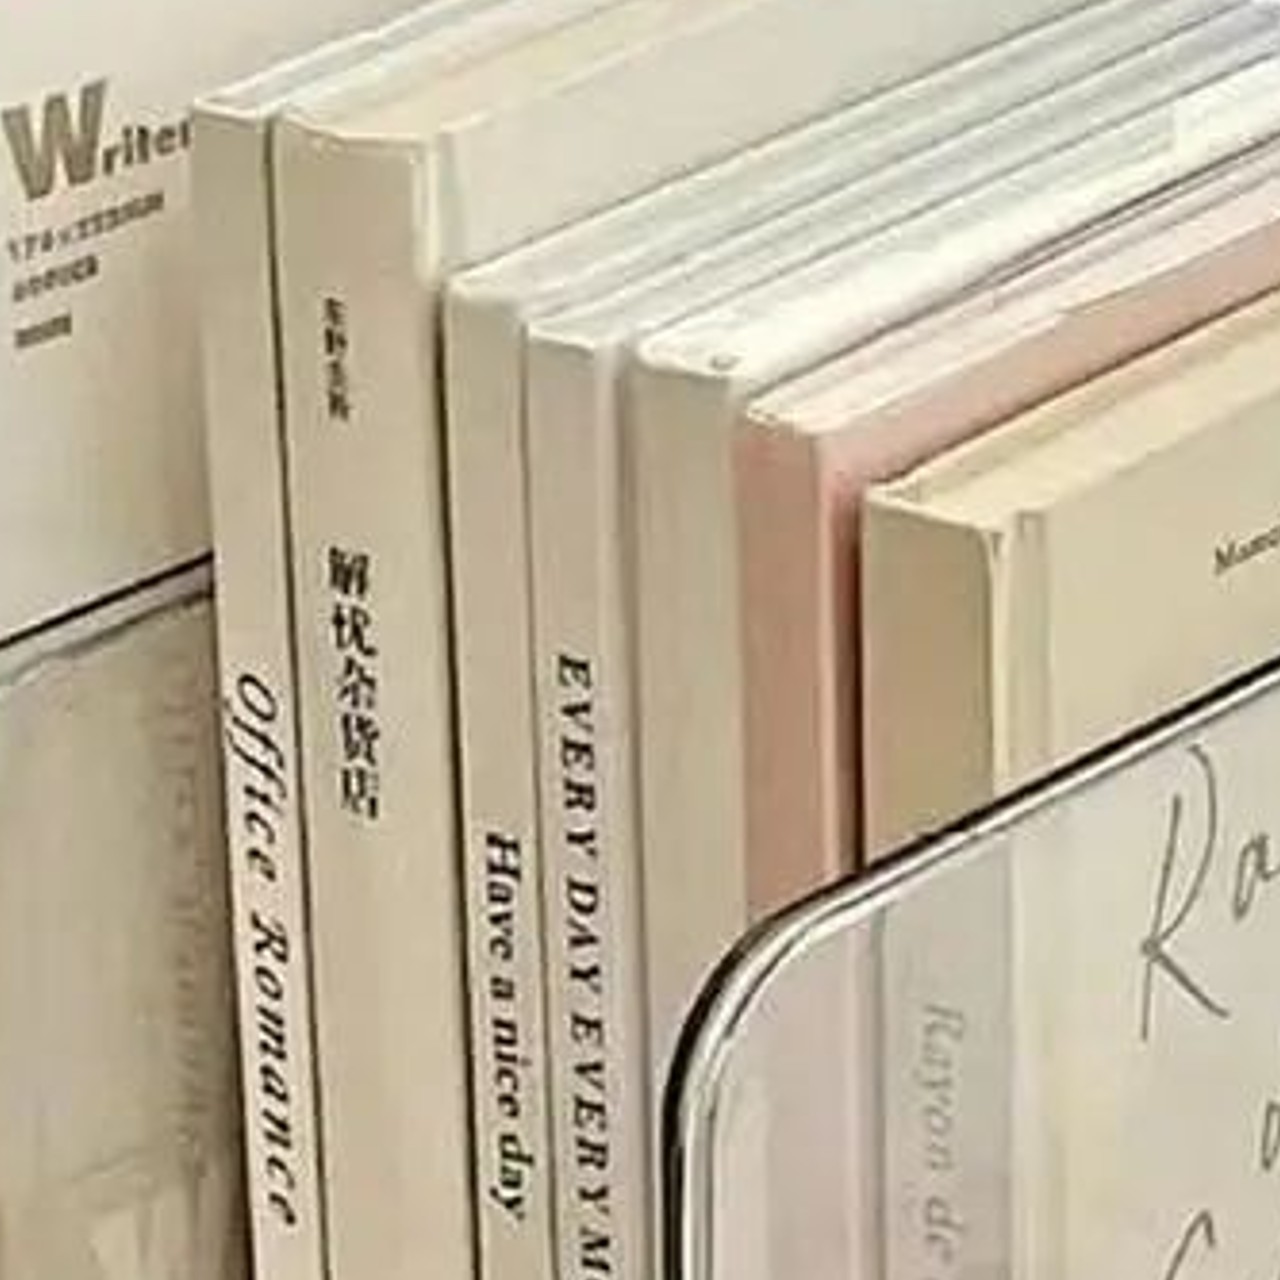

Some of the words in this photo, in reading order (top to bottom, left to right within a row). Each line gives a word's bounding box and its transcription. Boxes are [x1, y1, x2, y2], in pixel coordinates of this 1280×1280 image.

[329, 547, 379, 819] 解忧杂货店
[225, 674, 288, 881] Office
[558, 653, 597, 858] EVERY
[487, 832, 521, 962] Have
[567, 874, 601, 995] DAY
[490, 976, 515, 1001] a
[251, 910, 297, 1226] Romance
[492, 1017, 531, 1120] nice
[570, 1013, 610, 1215] EVERY
[489, 1131, 536, 1221] day
[925, 1195, 964, 1263] de
